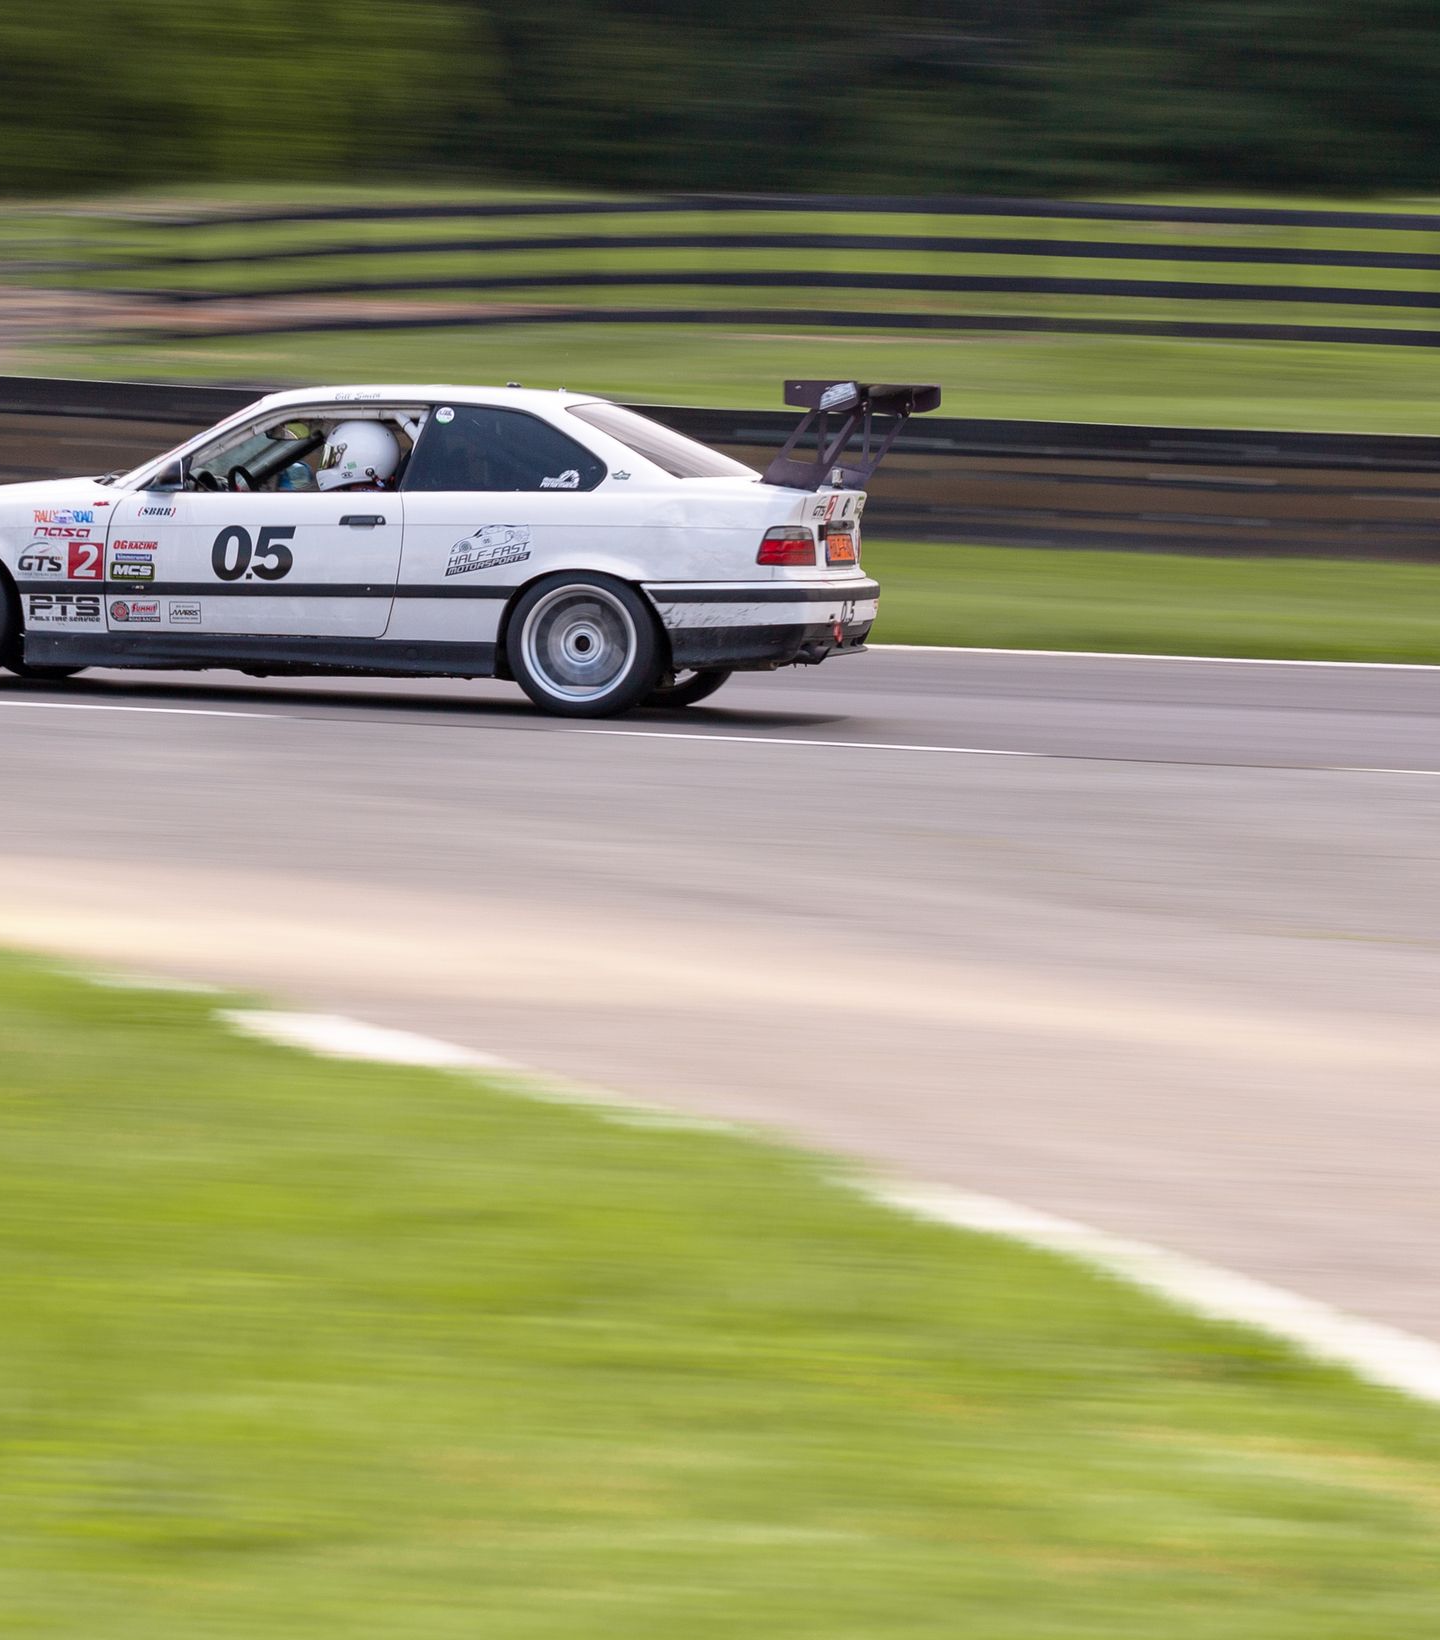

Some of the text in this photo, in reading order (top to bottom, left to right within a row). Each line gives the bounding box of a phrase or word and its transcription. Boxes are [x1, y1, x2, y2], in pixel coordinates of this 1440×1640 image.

[128, 541, 158, 550] RACING
[448, 541, 530, 567] HALF-FAST
[18, 555, 62, 572] GTS
[73, 544, 98, 577] 2
[112, 564, 152, 576] MCS
[446, 553, 528, 575] MOTORSPORTS
[29, 595, 100, 616] PTS
